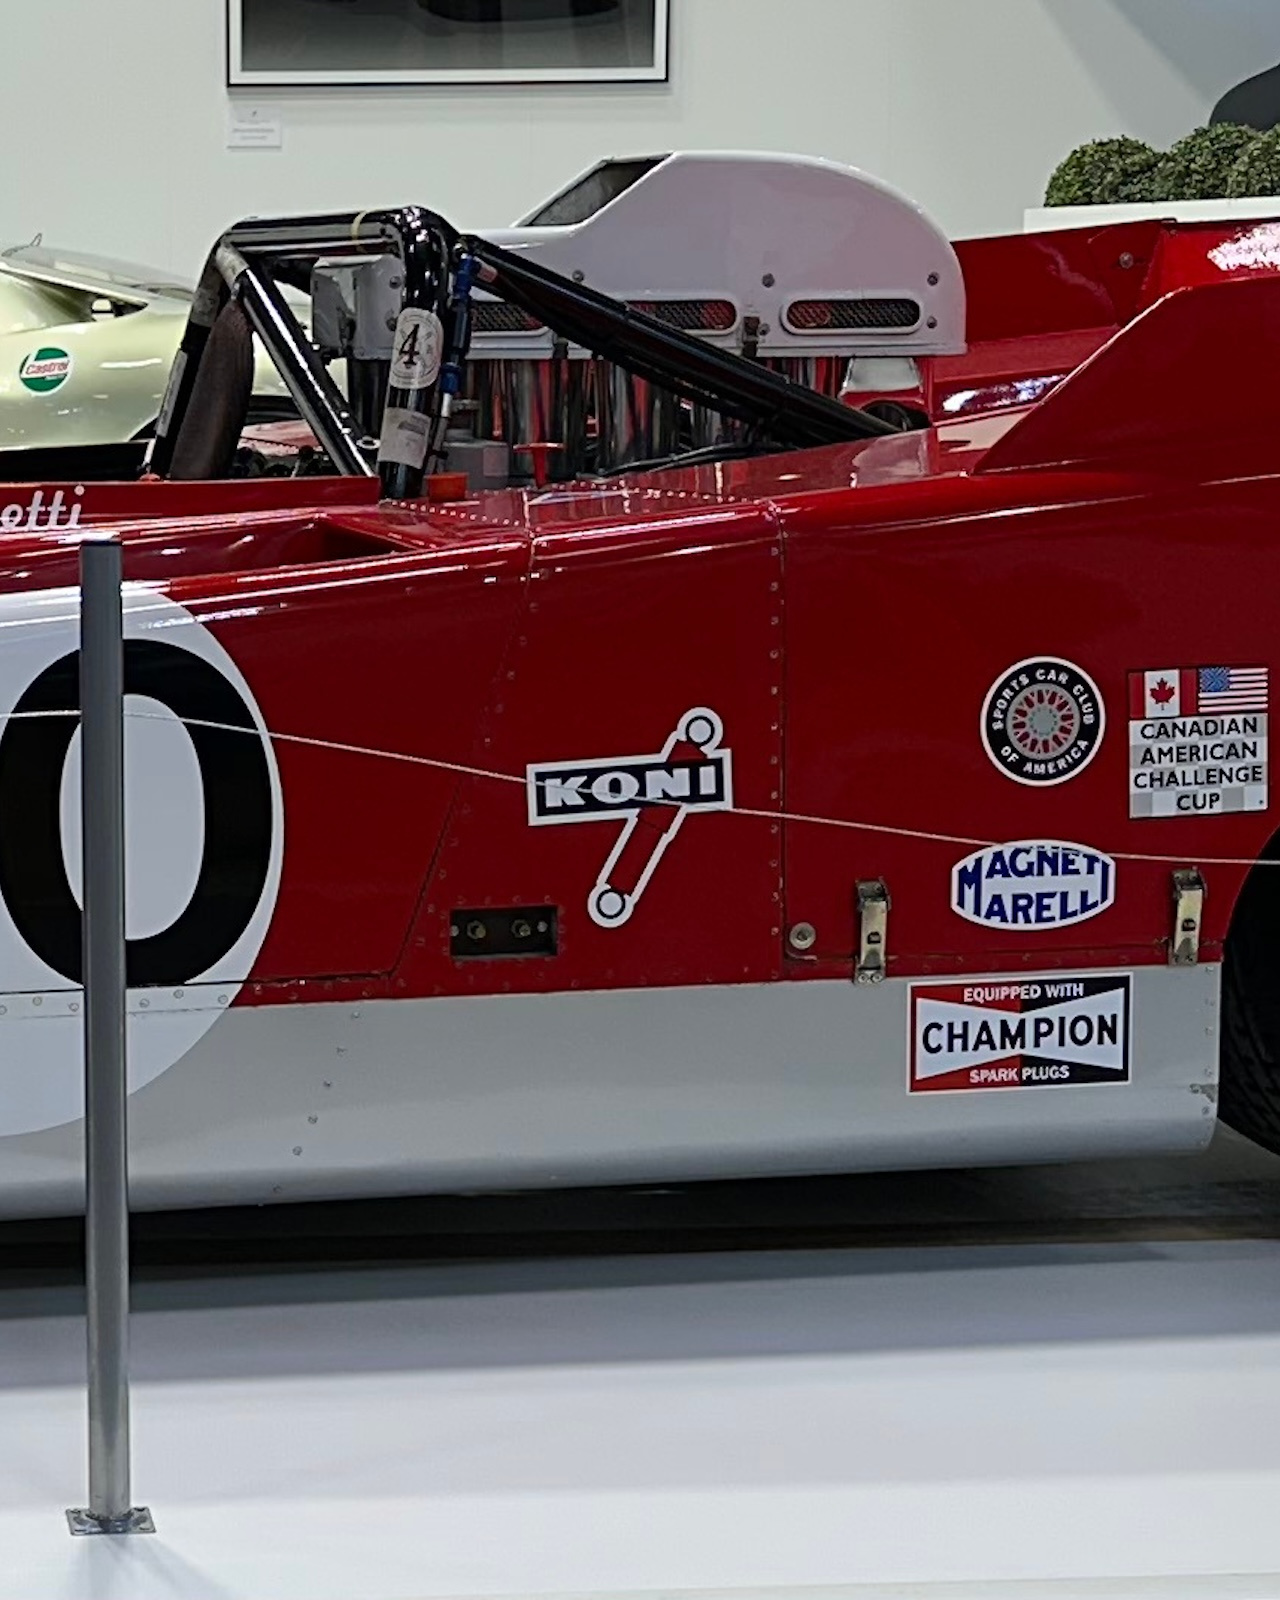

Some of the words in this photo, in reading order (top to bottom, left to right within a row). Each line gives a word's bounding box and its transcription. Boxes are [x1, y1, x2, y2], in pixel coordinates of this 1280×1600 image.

[399, 323, 420, 367] 4
[991, 673, 1030, 731] SPORTS
[1035, 668, 1069, 684] CAR
[1072, 684, 1095, 725] CLUB
[1140, 716, 1258, 739] CANADIAN
[1001, 745, 1020, 763] OF
[1023, 740, 1089, 775] AMERICA
[1140, 741, 1258, 765] AMERICAN
[545, 765, 716, 808] KONI
[1133, 765, 1263, 788] CHALLENGE
[1176, 793, 1220, 811] CUP
[963, 984, 1041, 1002] EQUIPPED
[1045, 983, 1084, 998] WITH
[922, 1013, 1117, 1054] CHAMPION
[969, 1067, 1018, 1083] SPARK
[1022, 1065, 1070, 1080] PLUGS
